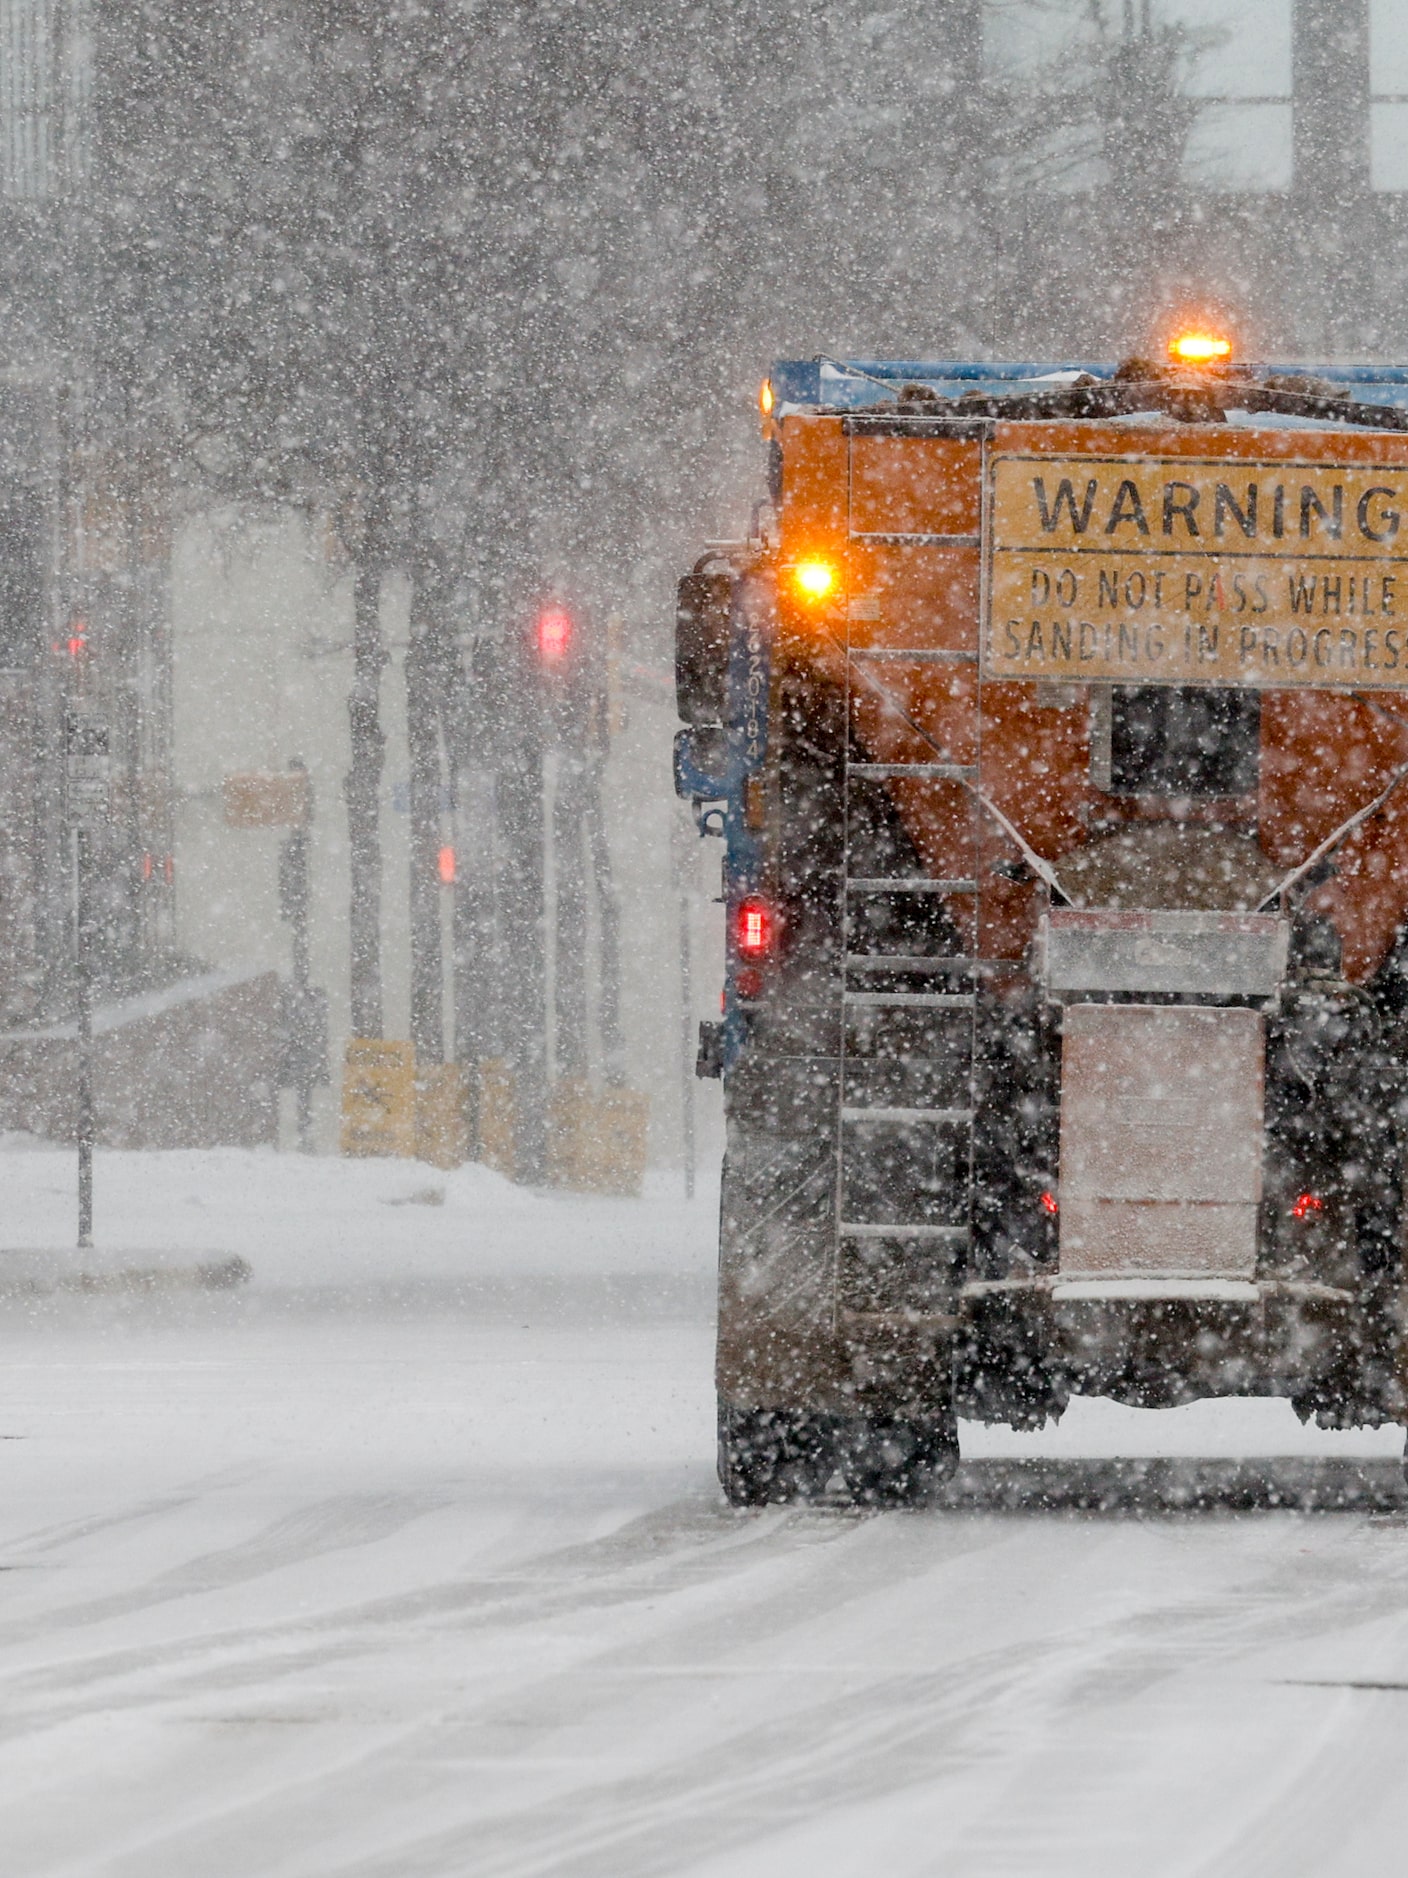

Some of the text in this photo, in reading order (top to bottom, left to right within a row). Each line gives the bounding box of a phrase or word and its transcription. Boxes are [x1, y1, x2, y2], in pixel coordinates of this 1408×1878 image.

[1033, 476, 1401, 541] WARNING
[1031, 568, 1397, 616] DO NOT PASS WHILE
[1004, 620, 1165, 662] SANDING
[1183, 625, 1219, 664] IN
